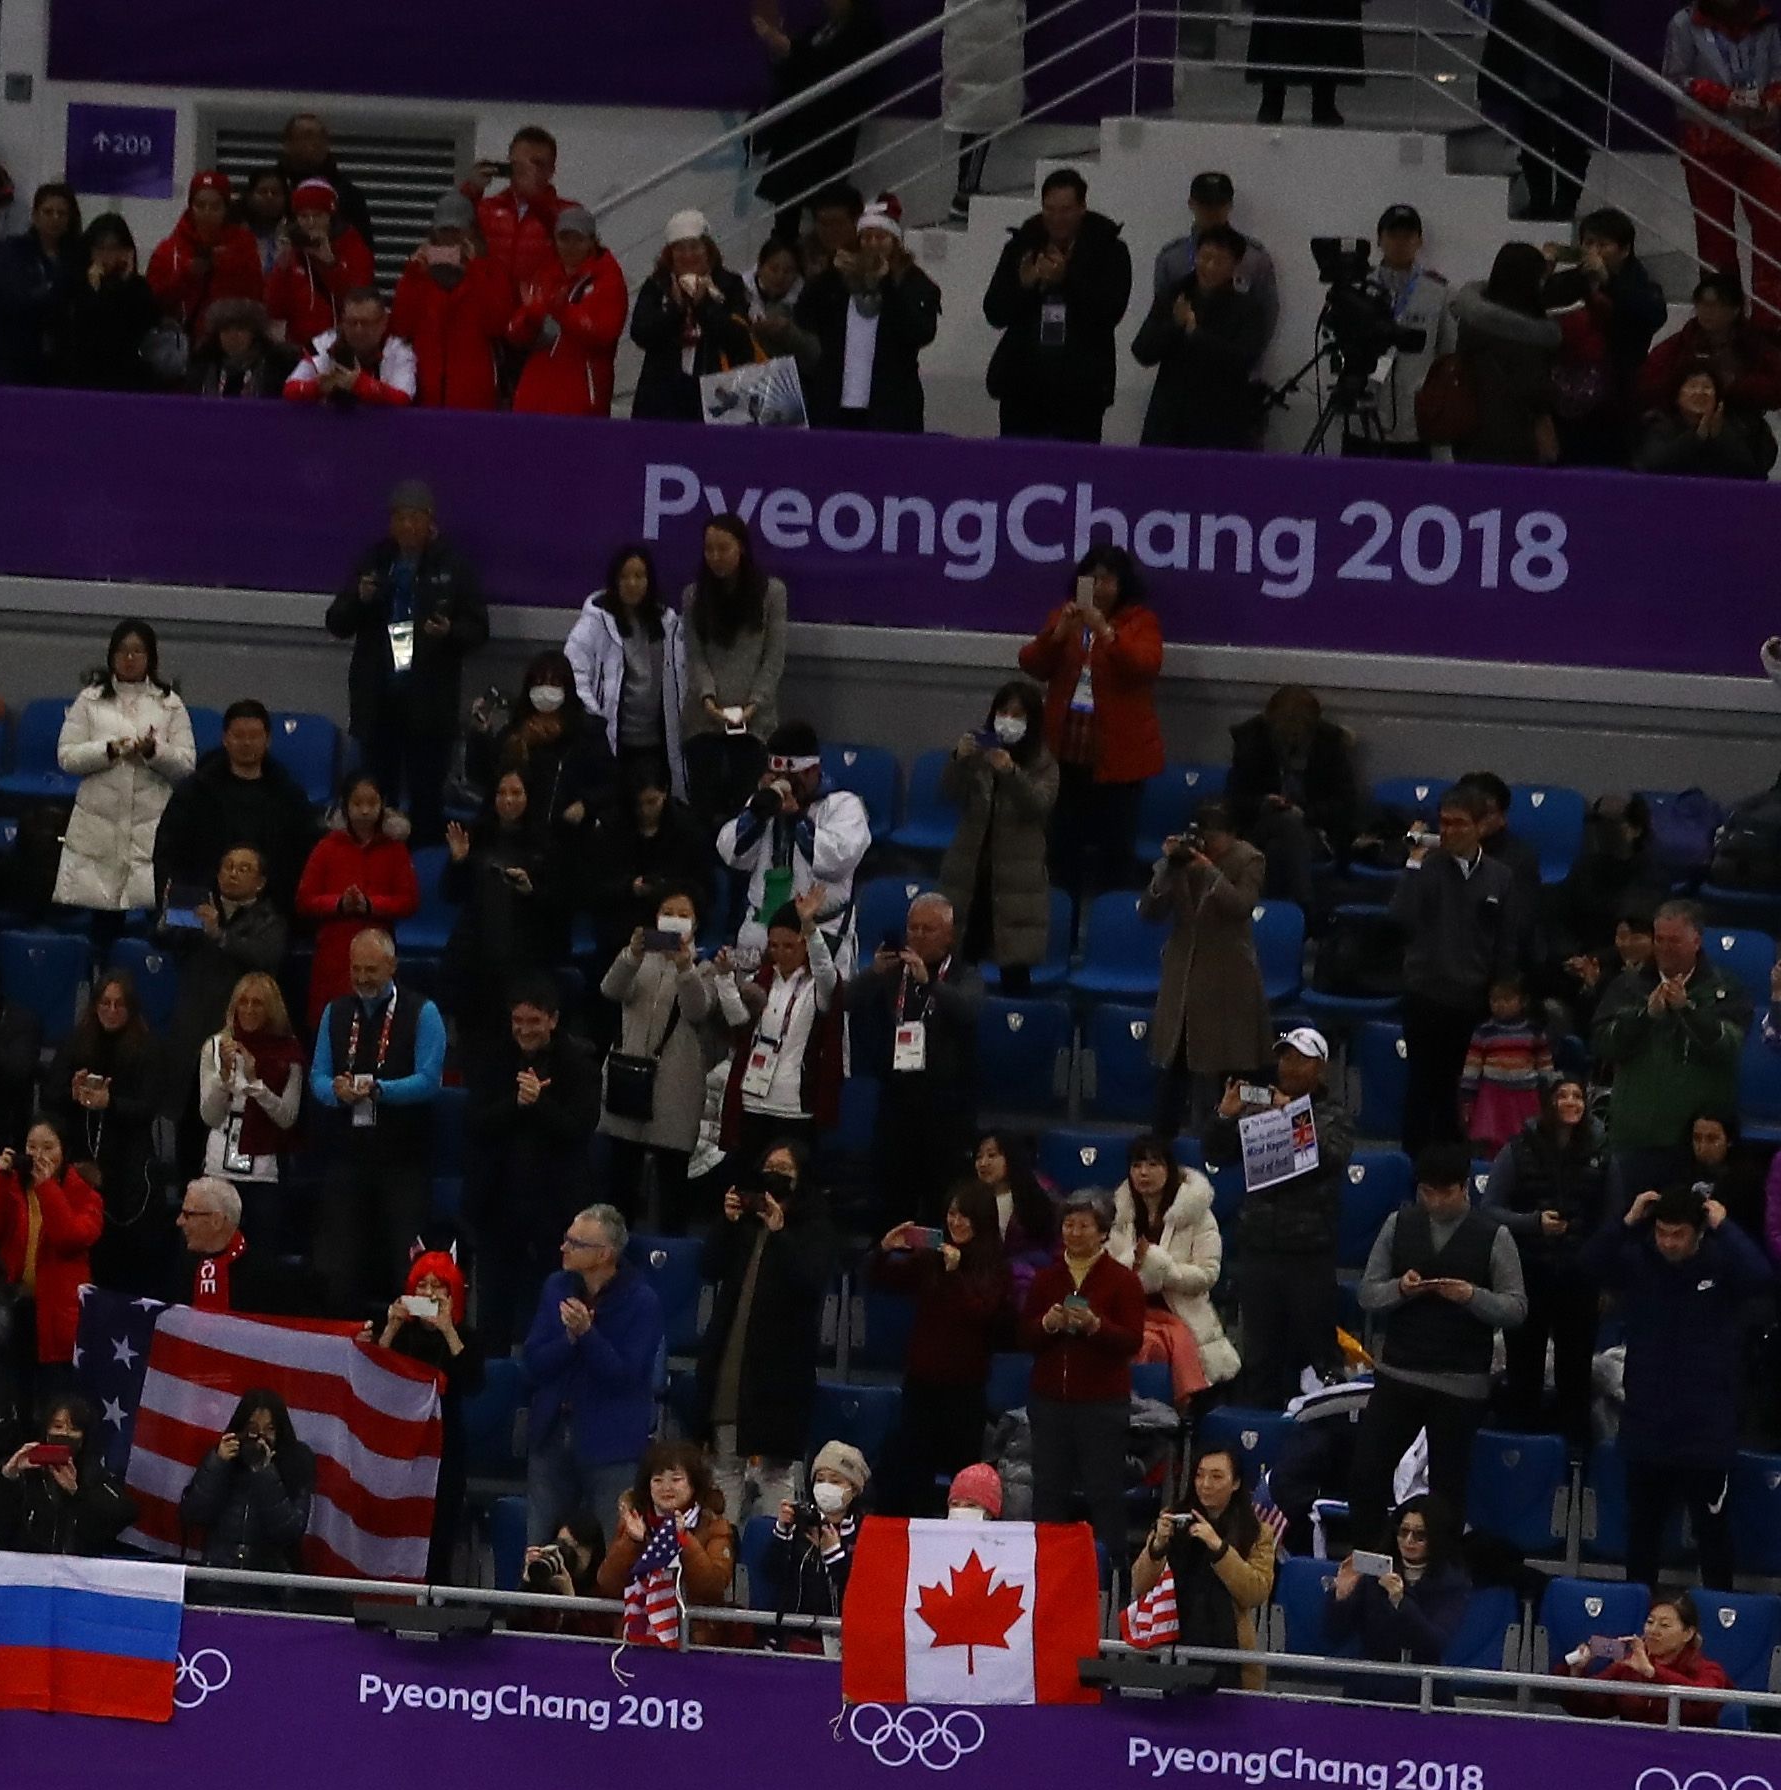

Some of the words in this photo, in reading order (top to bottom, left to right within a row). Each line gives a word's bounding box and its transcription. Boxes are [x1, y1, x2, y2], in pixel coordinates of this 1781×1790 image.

[643, 463, 1317, 599] PyeongChang
[1337, 501, 1569, 593] 2018
[359, 1673, 611, 1731] PyeongChang
[617, 1694, 704, 1731] 2018
